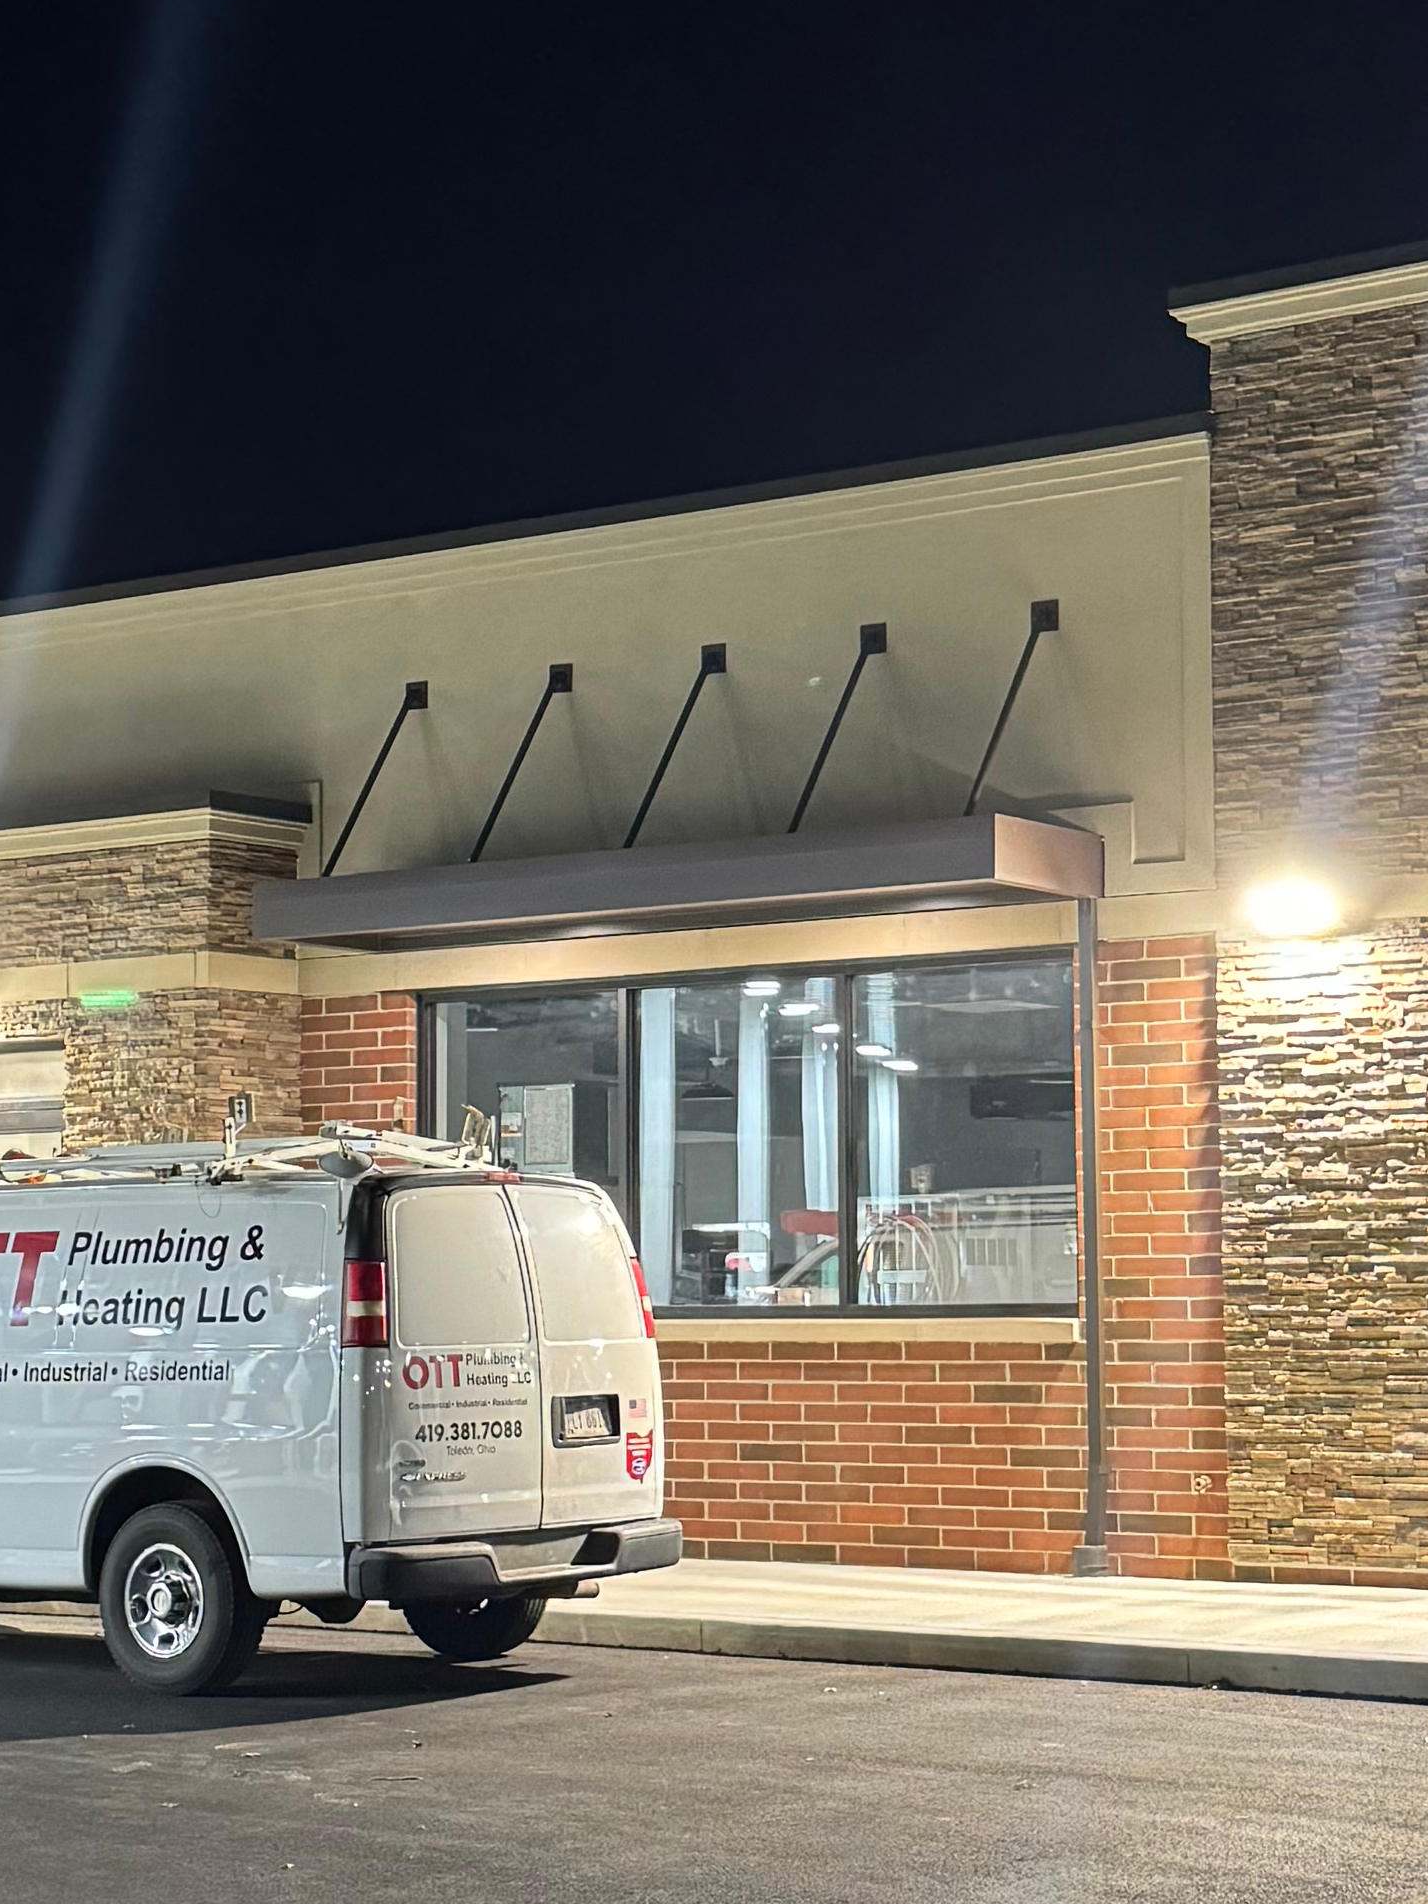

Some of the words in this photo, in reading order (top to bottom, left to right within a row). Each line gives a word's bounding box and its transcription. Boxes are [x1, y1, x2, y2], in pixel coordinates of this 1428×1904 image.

[67, 1228, 229, 1271] Plumbing
[240, 1224, 264, 1261] &
[57, 1288, 185, 1332] Heating
[196, 1284, 268, 1323] LLC
[466, 1352, 516, 1367] Plubing
[23, 1362, 108, 1382] Industrial
[124, 1361, 230, 1381] Residential
[402, 1354, 463, 1390] OTT
[466, 1374, 508, 1387] Heating
[415, 1420, 523, 1443] 419.381.7088
